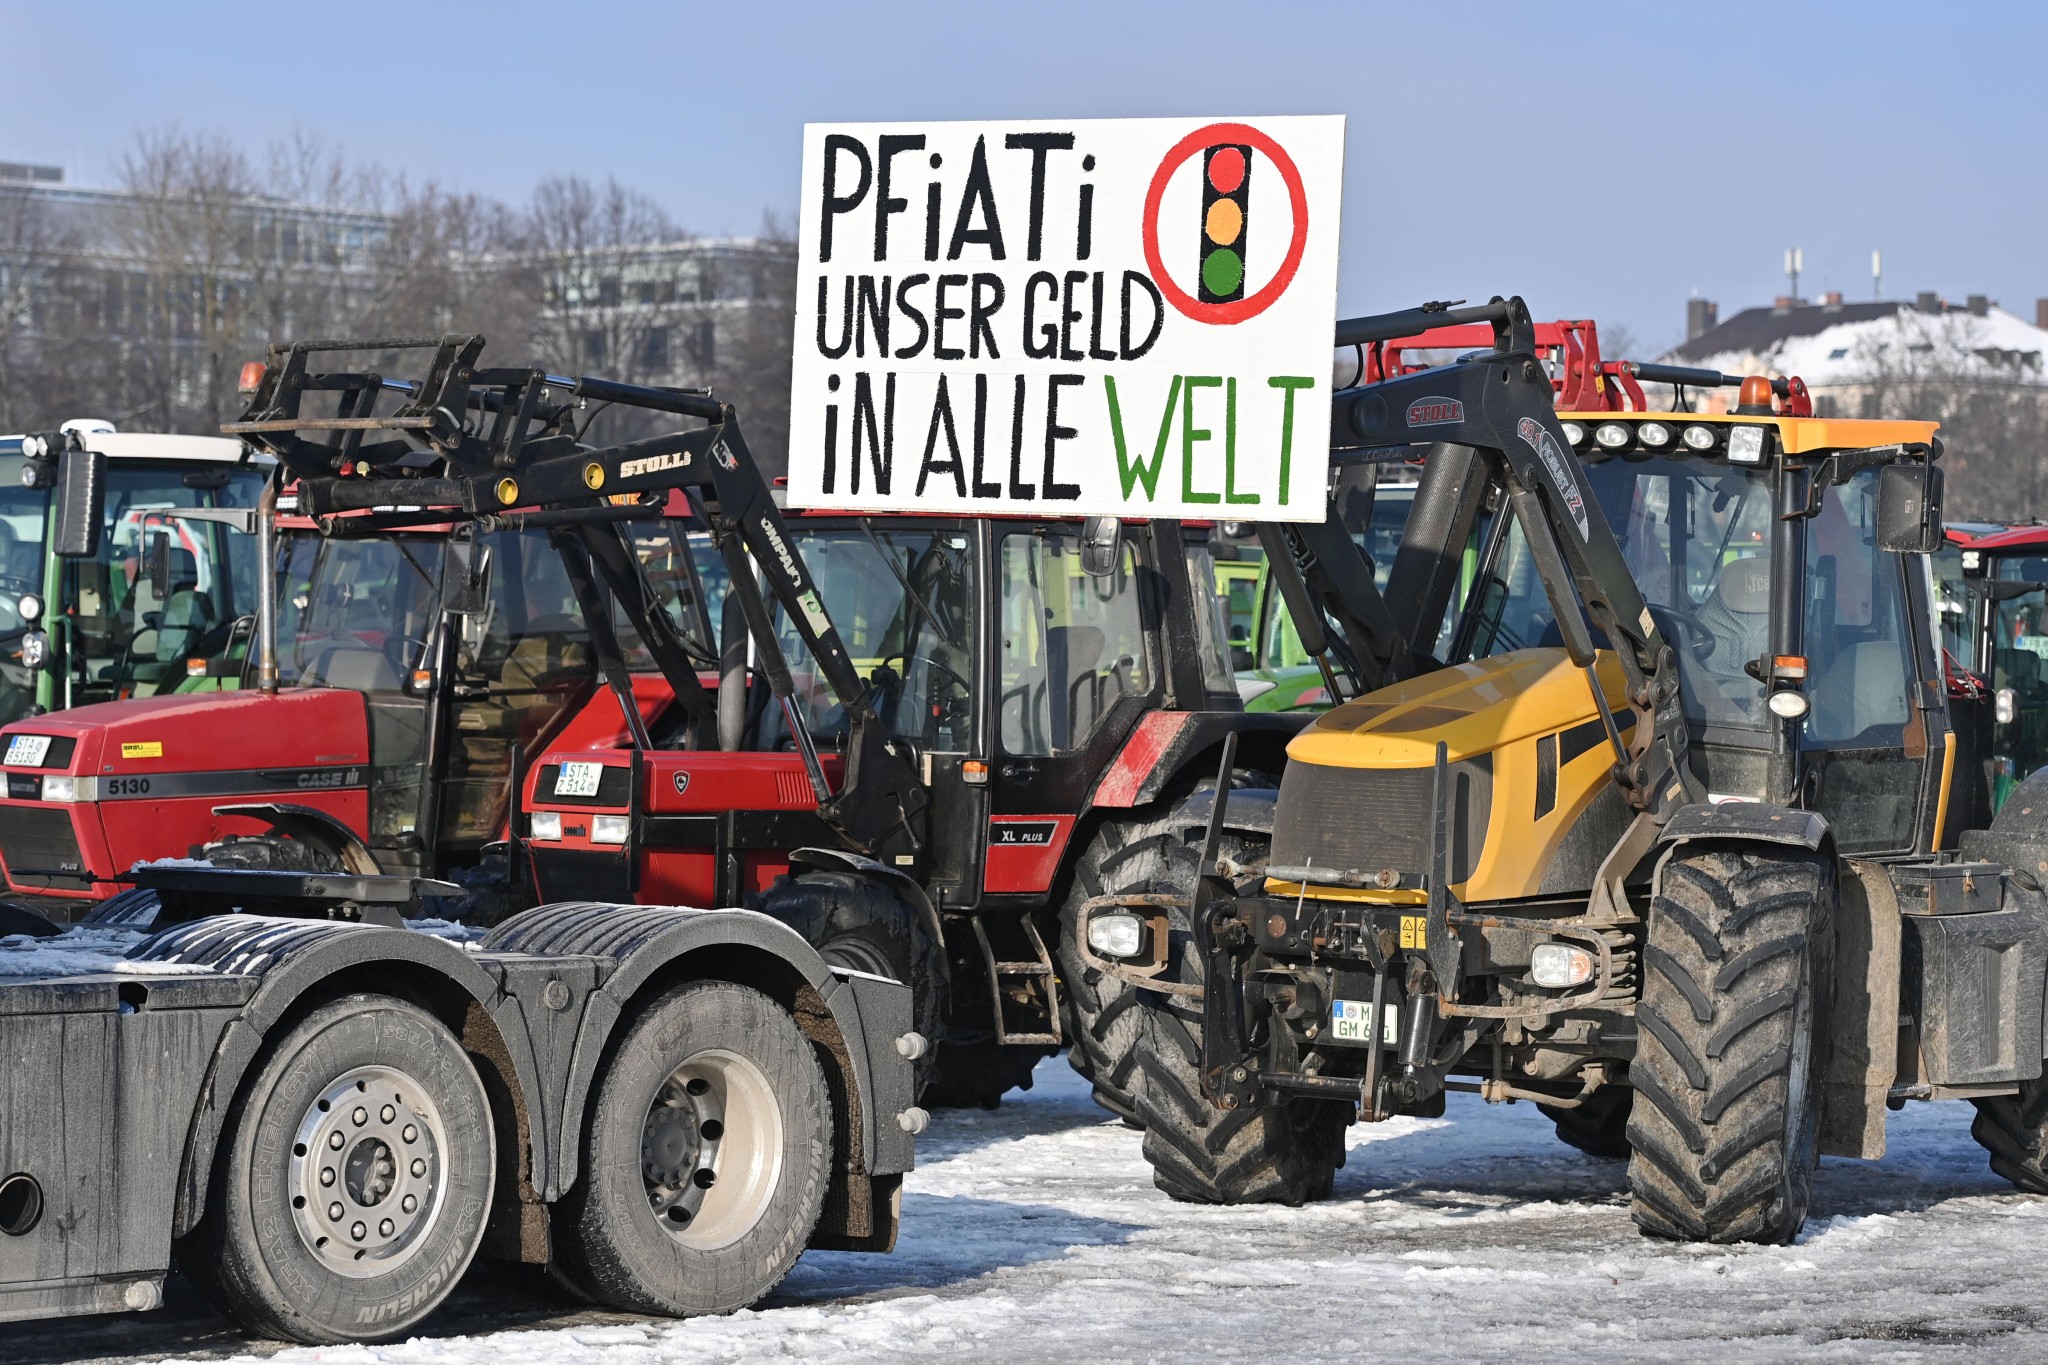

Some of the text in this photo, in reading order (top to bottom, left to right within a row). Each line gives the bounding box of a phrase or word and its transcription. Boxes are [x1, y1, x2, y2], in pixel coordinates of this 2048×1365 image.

[815, 270, 1165, 362] UNSER GELD
[1409, 402, 1460, 424] STOLL
[915, 372, 1085, 501] ALLE
[1103, 374, 1315, 506] WELT
[620, 452, 685, 479] STOLL
[1542, 441, 1569, 490] ROBUST
[16, 738, 36, 750] STA
[297, 772, 343, 787] CASE
[568, 764, 590, 779] STA
[108, 778, 150, 795] 5130
[566, 779, 586, 793] 514
[1002, 830, 1043, 842] XL PLUS
[60, 862, 78, 871] PLUS
[1361, 1005, 1370, 1021] M
[1339, 1020, 1358, 1038] GM
[259, 1052, 315, 1203] ENERGY
[463, 1093, 483, 1143] 22.5
[766, 1138, 823, 1276] MICHELIN
[355, 1238, 465, 1324] MICHELIN
